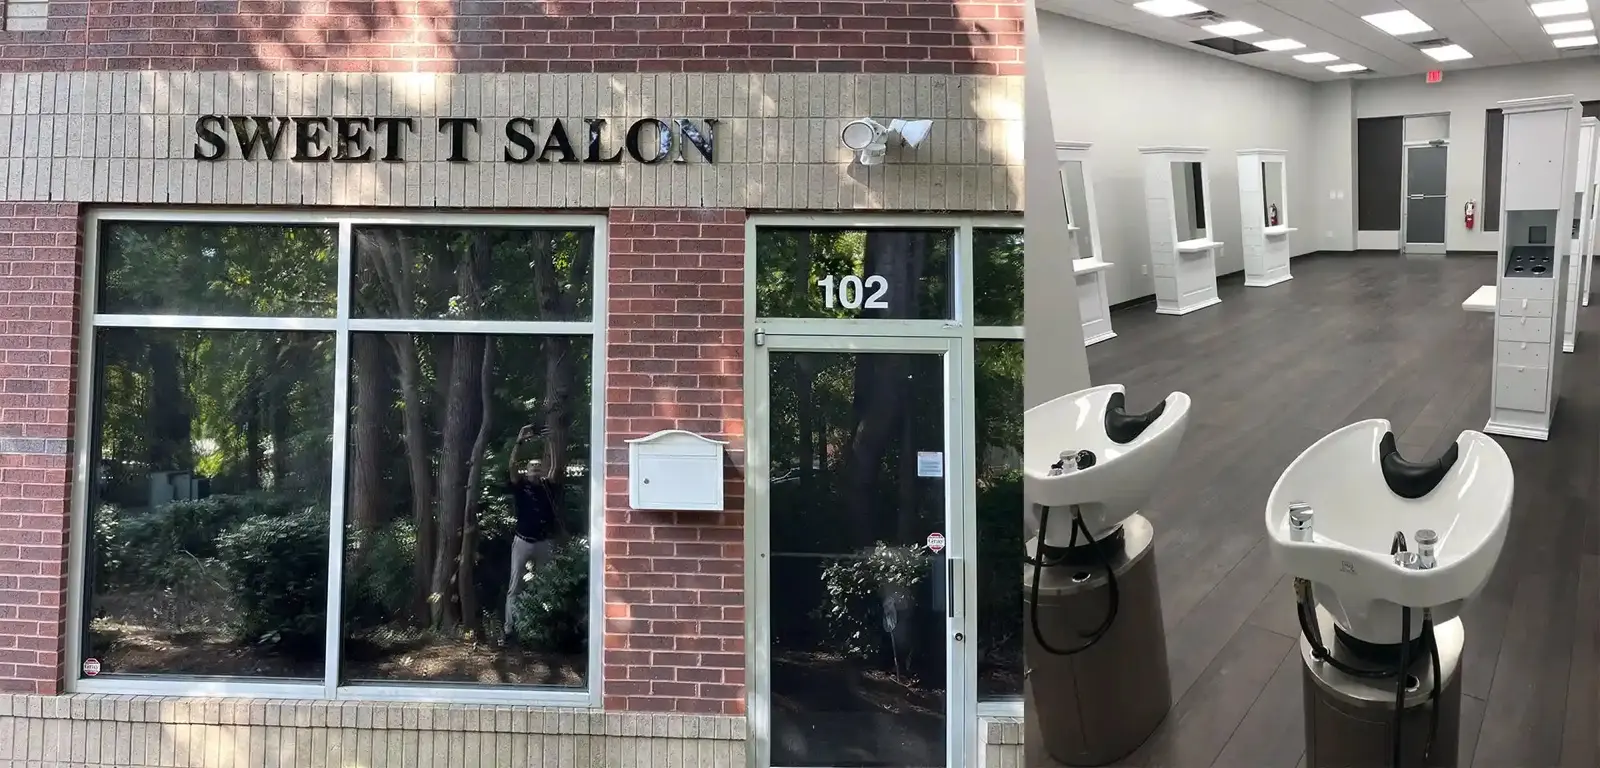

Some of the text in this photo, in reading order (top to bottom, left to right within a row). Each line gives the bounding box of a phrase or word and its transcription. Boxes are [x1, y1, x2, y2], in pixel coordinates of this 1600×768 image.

[194, 115, 719, 164] SWEET T SALON
[817, 274, 889, 309] 102
